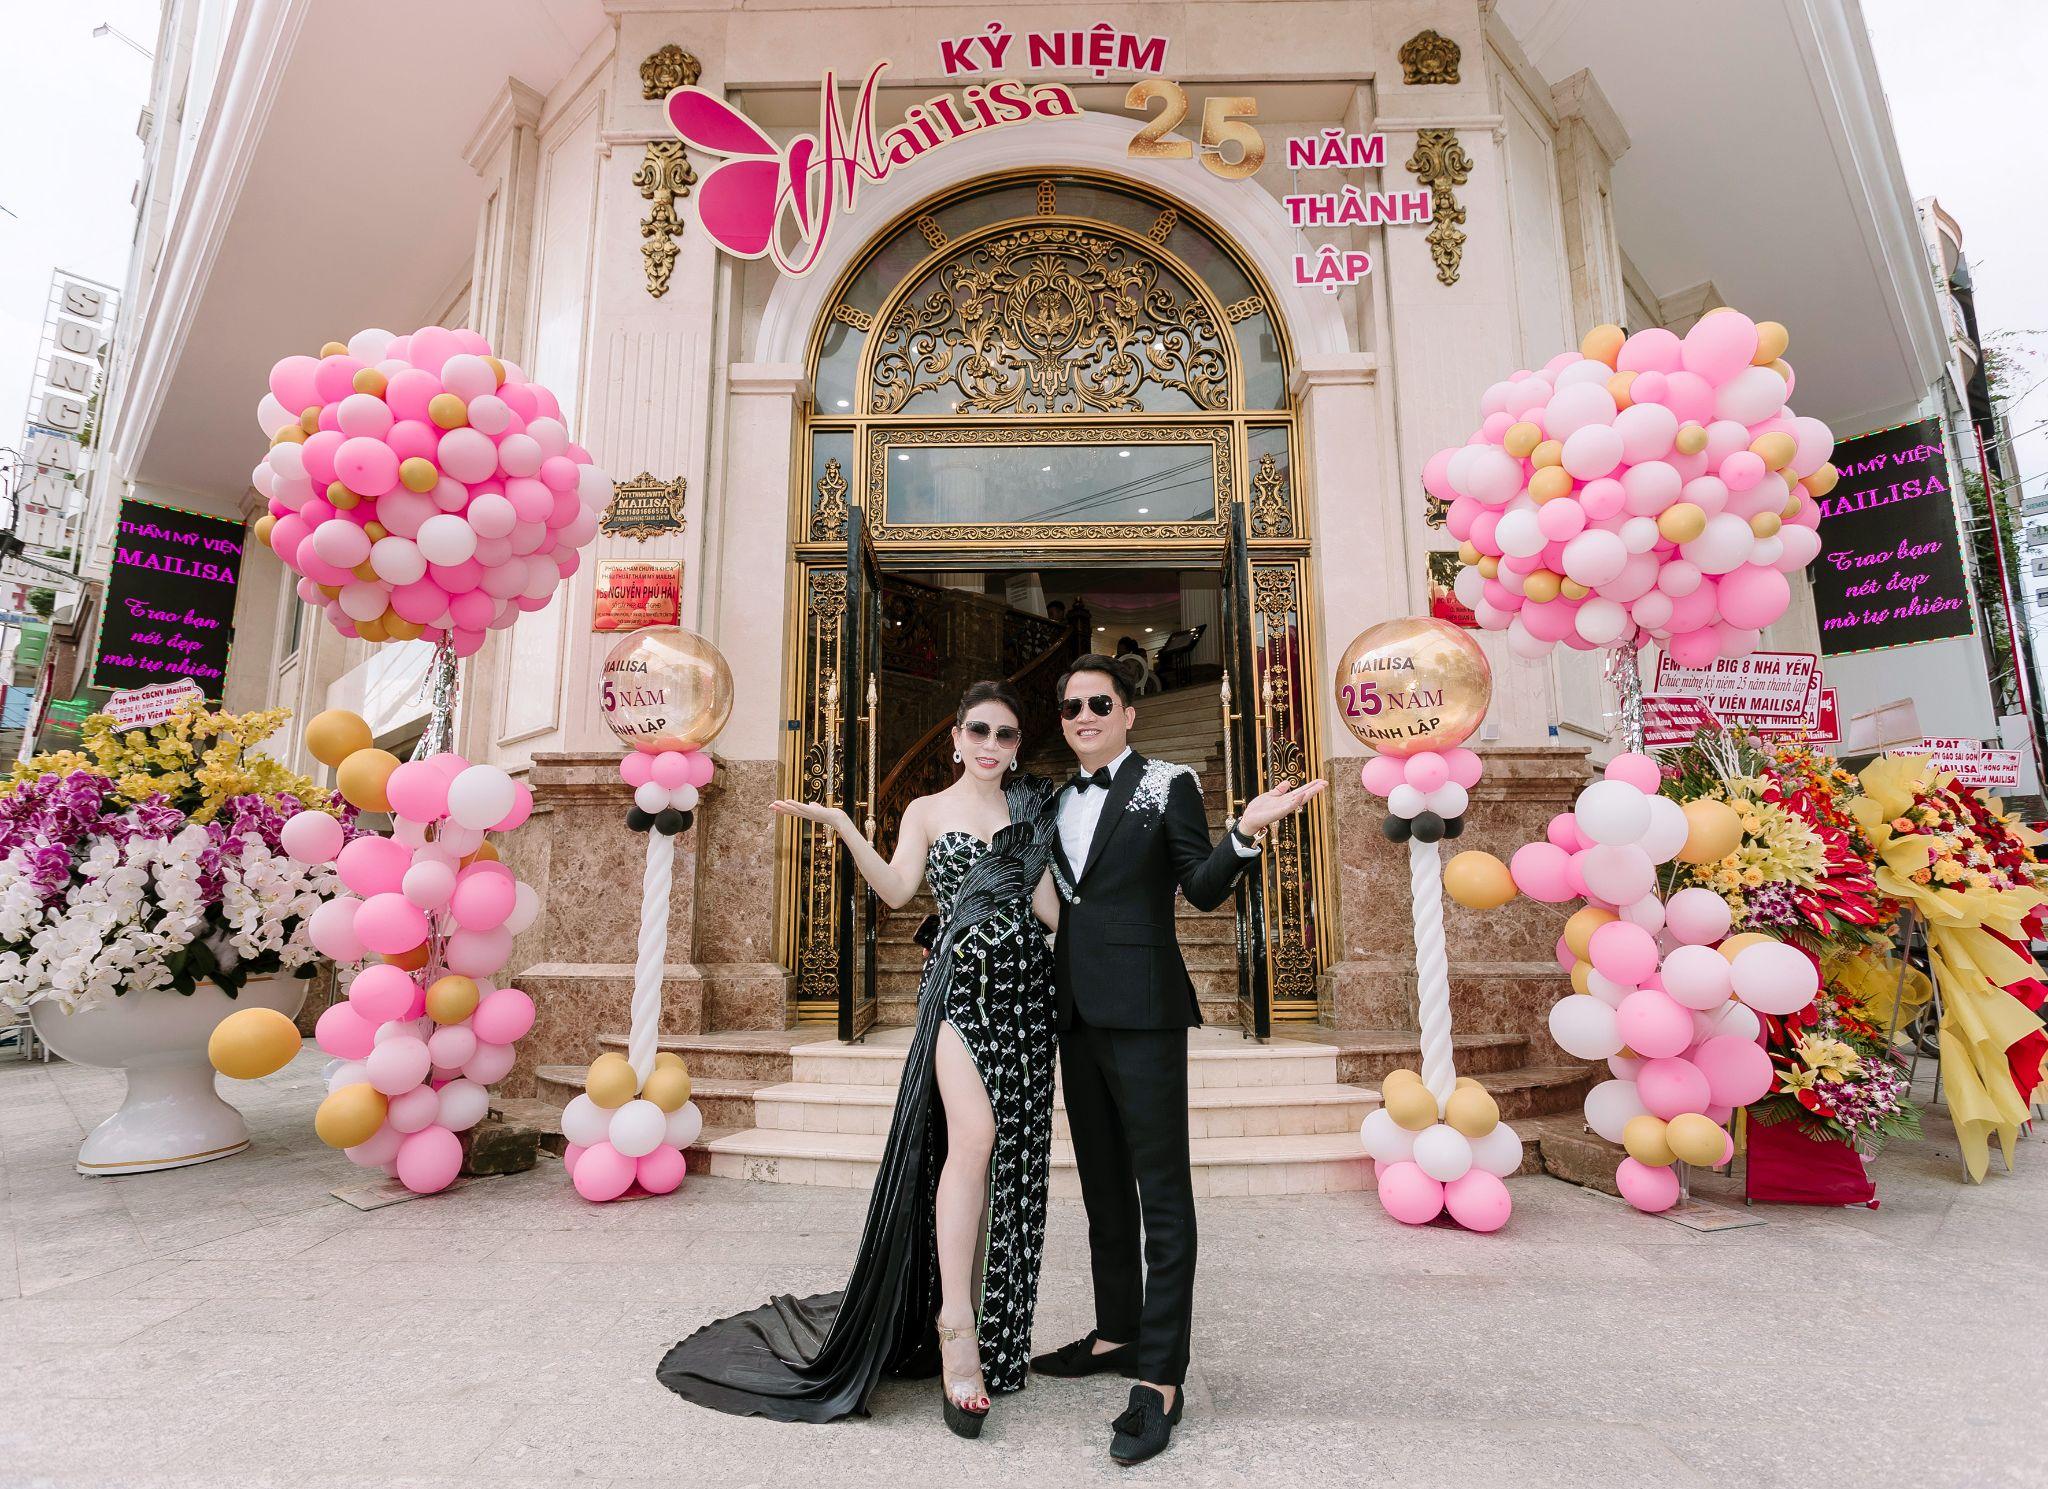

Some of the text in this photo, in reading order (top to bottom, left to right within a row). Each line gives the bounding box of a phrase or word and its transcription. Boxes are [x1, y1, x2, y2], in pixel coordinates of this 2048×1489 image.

[940, 22, 1168, 77] KỶ NIỆM
[1125, 79, 1266, 180] 25
[1289, 130, 1384, 166] NĂM
[1286, 187, 1429, 224] THÀNH
[1295, 247, 1370, 291] LẬP
[1892, 442, 1944, 466] VIỆN
[618, 498, 670, 508] MAILISA
[203, 537, 243, 556] VIỆN
[1896, 538, 1943, 560] bạn
[115, 547, 236, 585] MAILISA
[1844, 569, 1932, 598] nét đẹp
[182, 608, 220, 629] bạn
[1893, 595, 1964, 619] nhiên
[130, 631, 205, 655] nét đẹp
[165, 657, 222, 679] nhiên
[1350, 657, 1415, 675] MAILISA
[1716, 659, 1738, 673] BIG
[1742, 660, 1750, 674] 8
[1753, 655, 1781, 676] NHÀ
[1786, 657, 1812, 677] YẾN
[141, 689, 164, 700] CBCNV
[166, 685, 192, 695] Mailisa
[1659, 672, 1680, 688] Chúc
[1681, 675, 1703, 691] mừng
[1704, 675, 1715, 690] kỷ
[1716, 676, 1736, 693] niệm
[1736, 676, 1747, 690] 25
[1748, 679, 1766, 691] năm
[1766, 677, 1791, 692] thành
[1792, 678, 1807, 697] lập
[600, 681, 667, 712] 5 NĂM
[1342, 681, 1444, 717] 25 NĂM
[1718, 692, 1748, 713] VIỆN
[1750, 697, 1801, 713] MAILISA
[638, 718, 667, 734] LẬP
[1350, 717, 1441, 740] THÀNH LẬP
[1806, 730, 1834, 740] Mailisa
[1988, 775, 2016, 784] MAILISA
